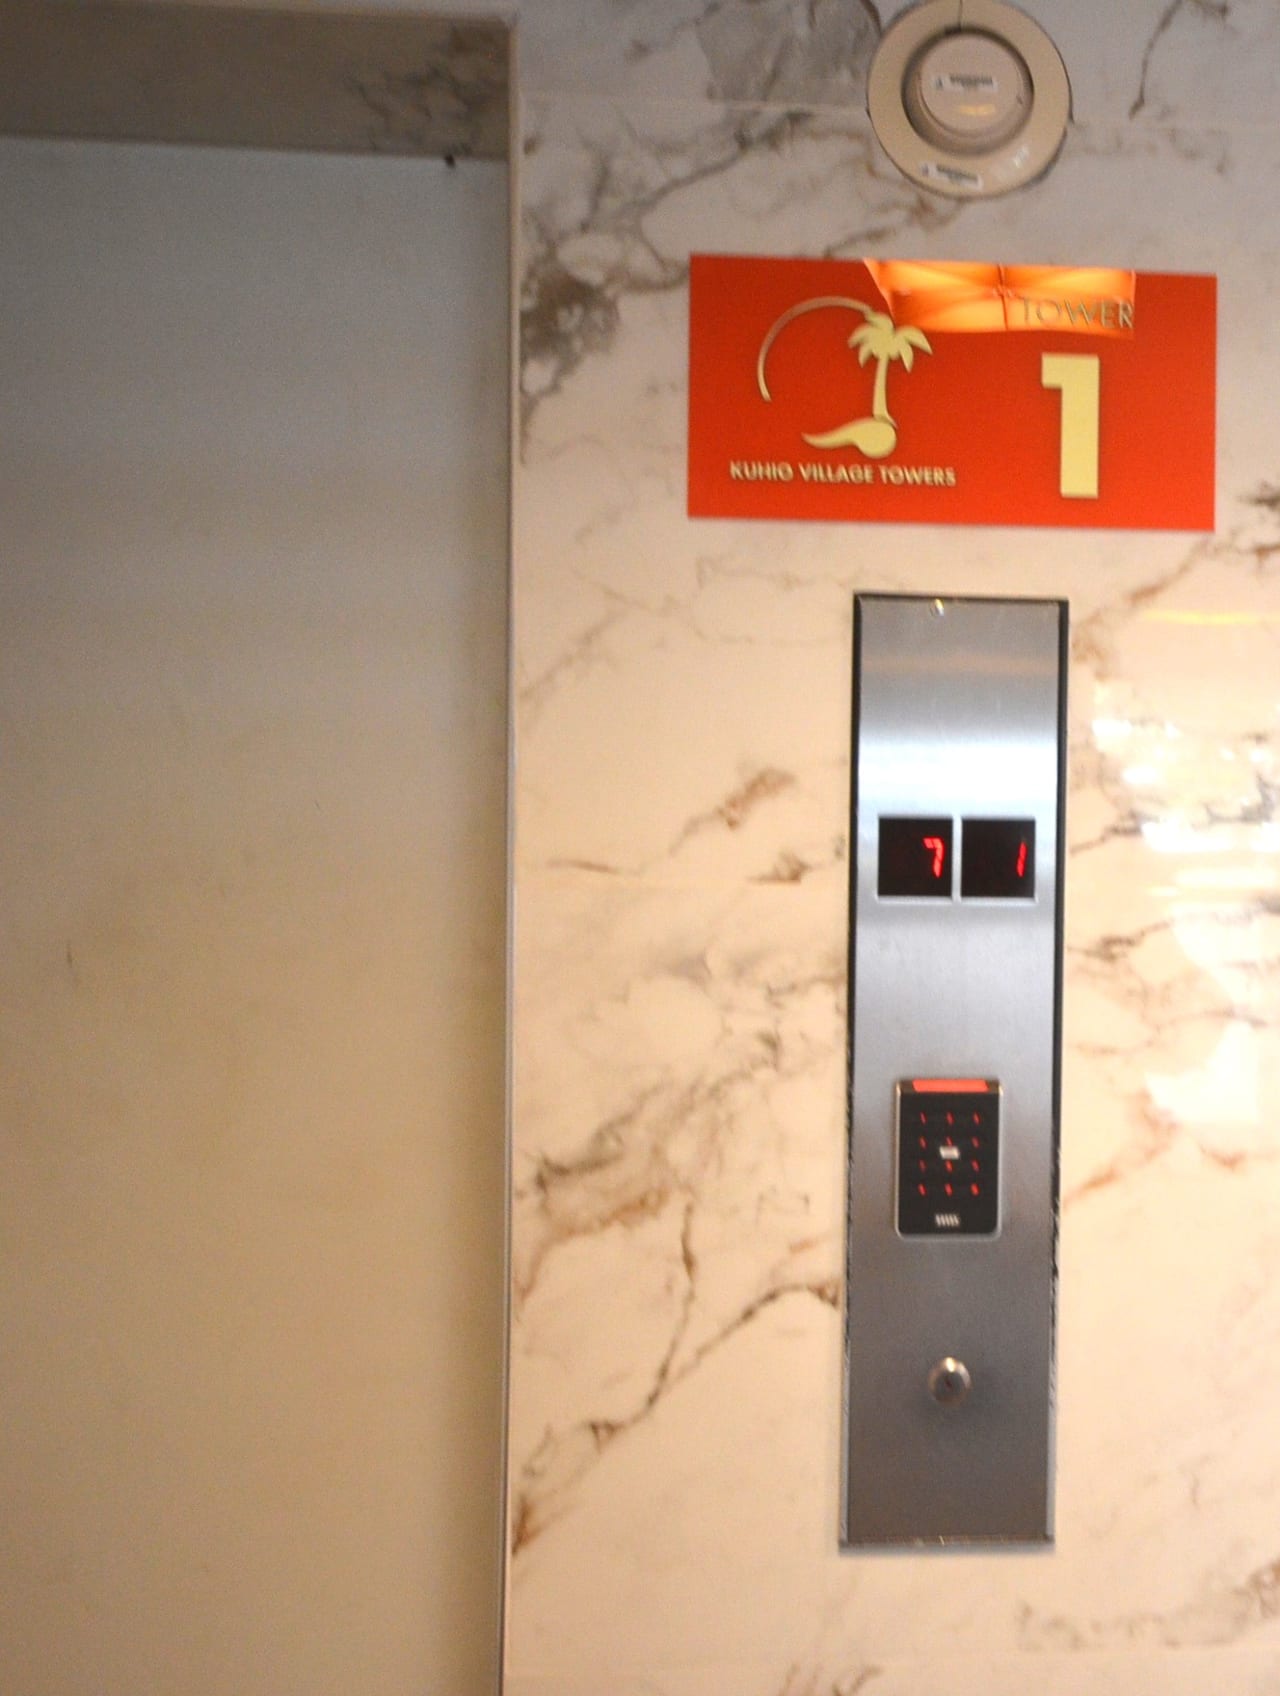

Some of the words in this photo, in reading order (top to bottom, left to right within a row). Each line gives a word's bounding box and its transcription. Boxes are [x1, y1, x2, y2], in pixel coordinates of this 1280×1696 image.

[1018, 297, 1135, 330] TOWER
[1041, 352, 1100, 500] 1
[729, 460, 794, 482] KUHIO
[799, 462, 874, 484] VILLAGE
[879, 464, 957, 487] TOWERS
[923, 837, 944, 878] 7
[1016, 840, 1027, 878] 1
